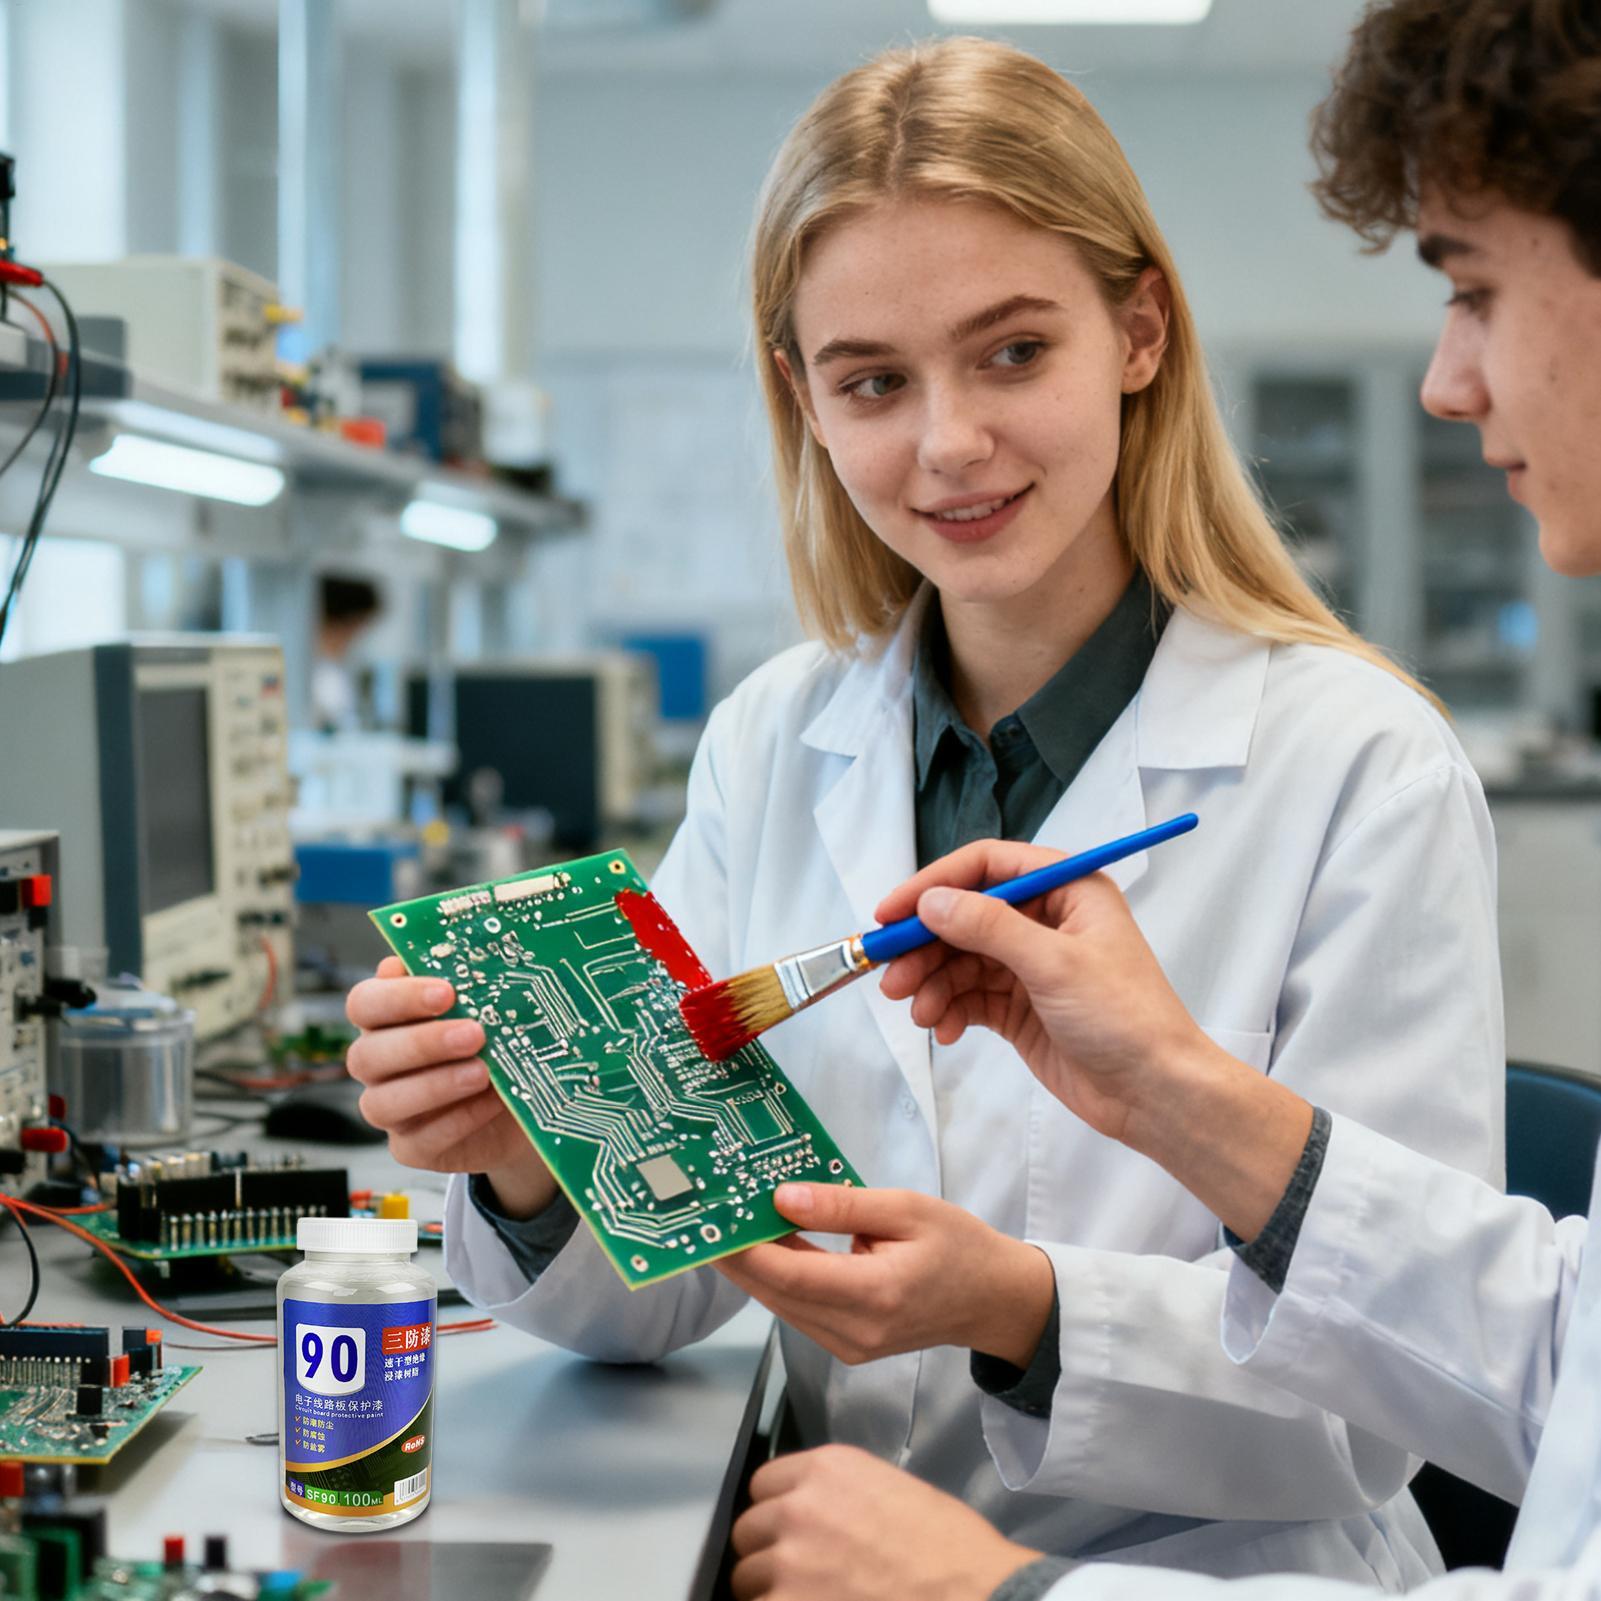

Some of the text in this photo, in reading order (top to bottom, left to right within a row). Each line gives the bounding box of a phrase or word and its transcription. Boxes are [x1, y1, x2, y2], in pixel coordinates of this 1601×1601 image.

[385, 1326, 431, 1350] 三防漆
[302, 1332, 358, 1382] 90
[295, 1393, 384, 1412] 电子线路板保护漆
[313, 1410, 330, 1418] board
[306, 1490, 337, 1505] SF90
